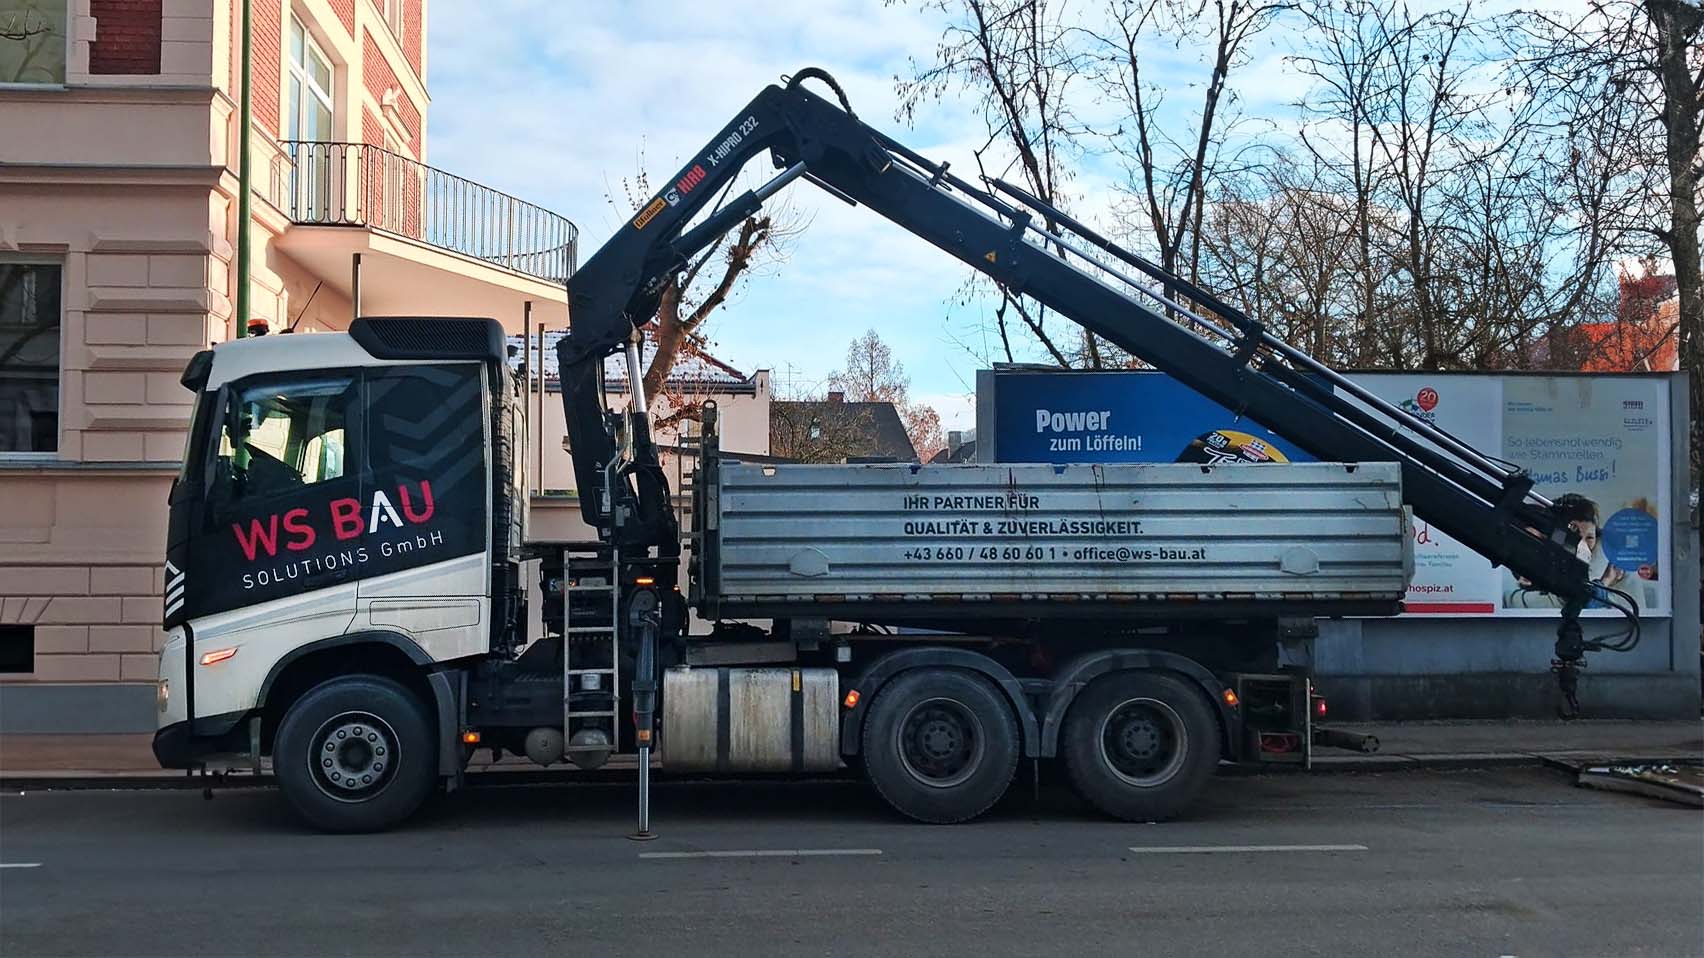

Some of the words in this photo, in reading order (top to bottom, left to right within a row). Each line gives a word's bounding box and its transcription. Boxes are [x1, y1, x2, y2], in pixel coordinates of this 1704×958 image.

[706, 131, 743, 167] X-HIPRO
[738, 115, 760, 137] 232
[676, 163, 707, 195] HIAB
[1420, 390, 1437, 401] 20
[1036, 409, 1111, 433] Power
[1050, 438, 1081, 451] zum
[1086, 435, 1142, 451] Löffeln!
[1507, 437, 1522, 448] So
[1525, 436, 1622, 450] lebensnotwendig
[1575, 459, 1617, 483] Bussi!
[903, 496, 930, 510] IHR
[933, 496, 1005, 510] PARTNER
[1009, 493, 1040, 510] FÜR
[232, 507, 317, 562] WS
[329, 479, 435, 541] BAU
[904, 519, 979, 536] QUALITÄT
[982, 522, 993, 535] &
[997, 519, 1144, 535] ZUVERLÄSSIGKEIT.
[242, 547, 369, 590] SOLUTIONS
[381, 530, 443, 558] GmbH
[903, 547, 932, 561] +43
[936, 547, 963, 561] 660
[979, 547, 998, 561] 48
[1002, 547, 1021, 561] 60
[1025, 547, 1044, 561] 60
[1049, 547, 1056, 561] 1
[1073, 547, 1206, 562] office@ws-bau.at
[1408, 583, 1454, 595] hospiz.at
